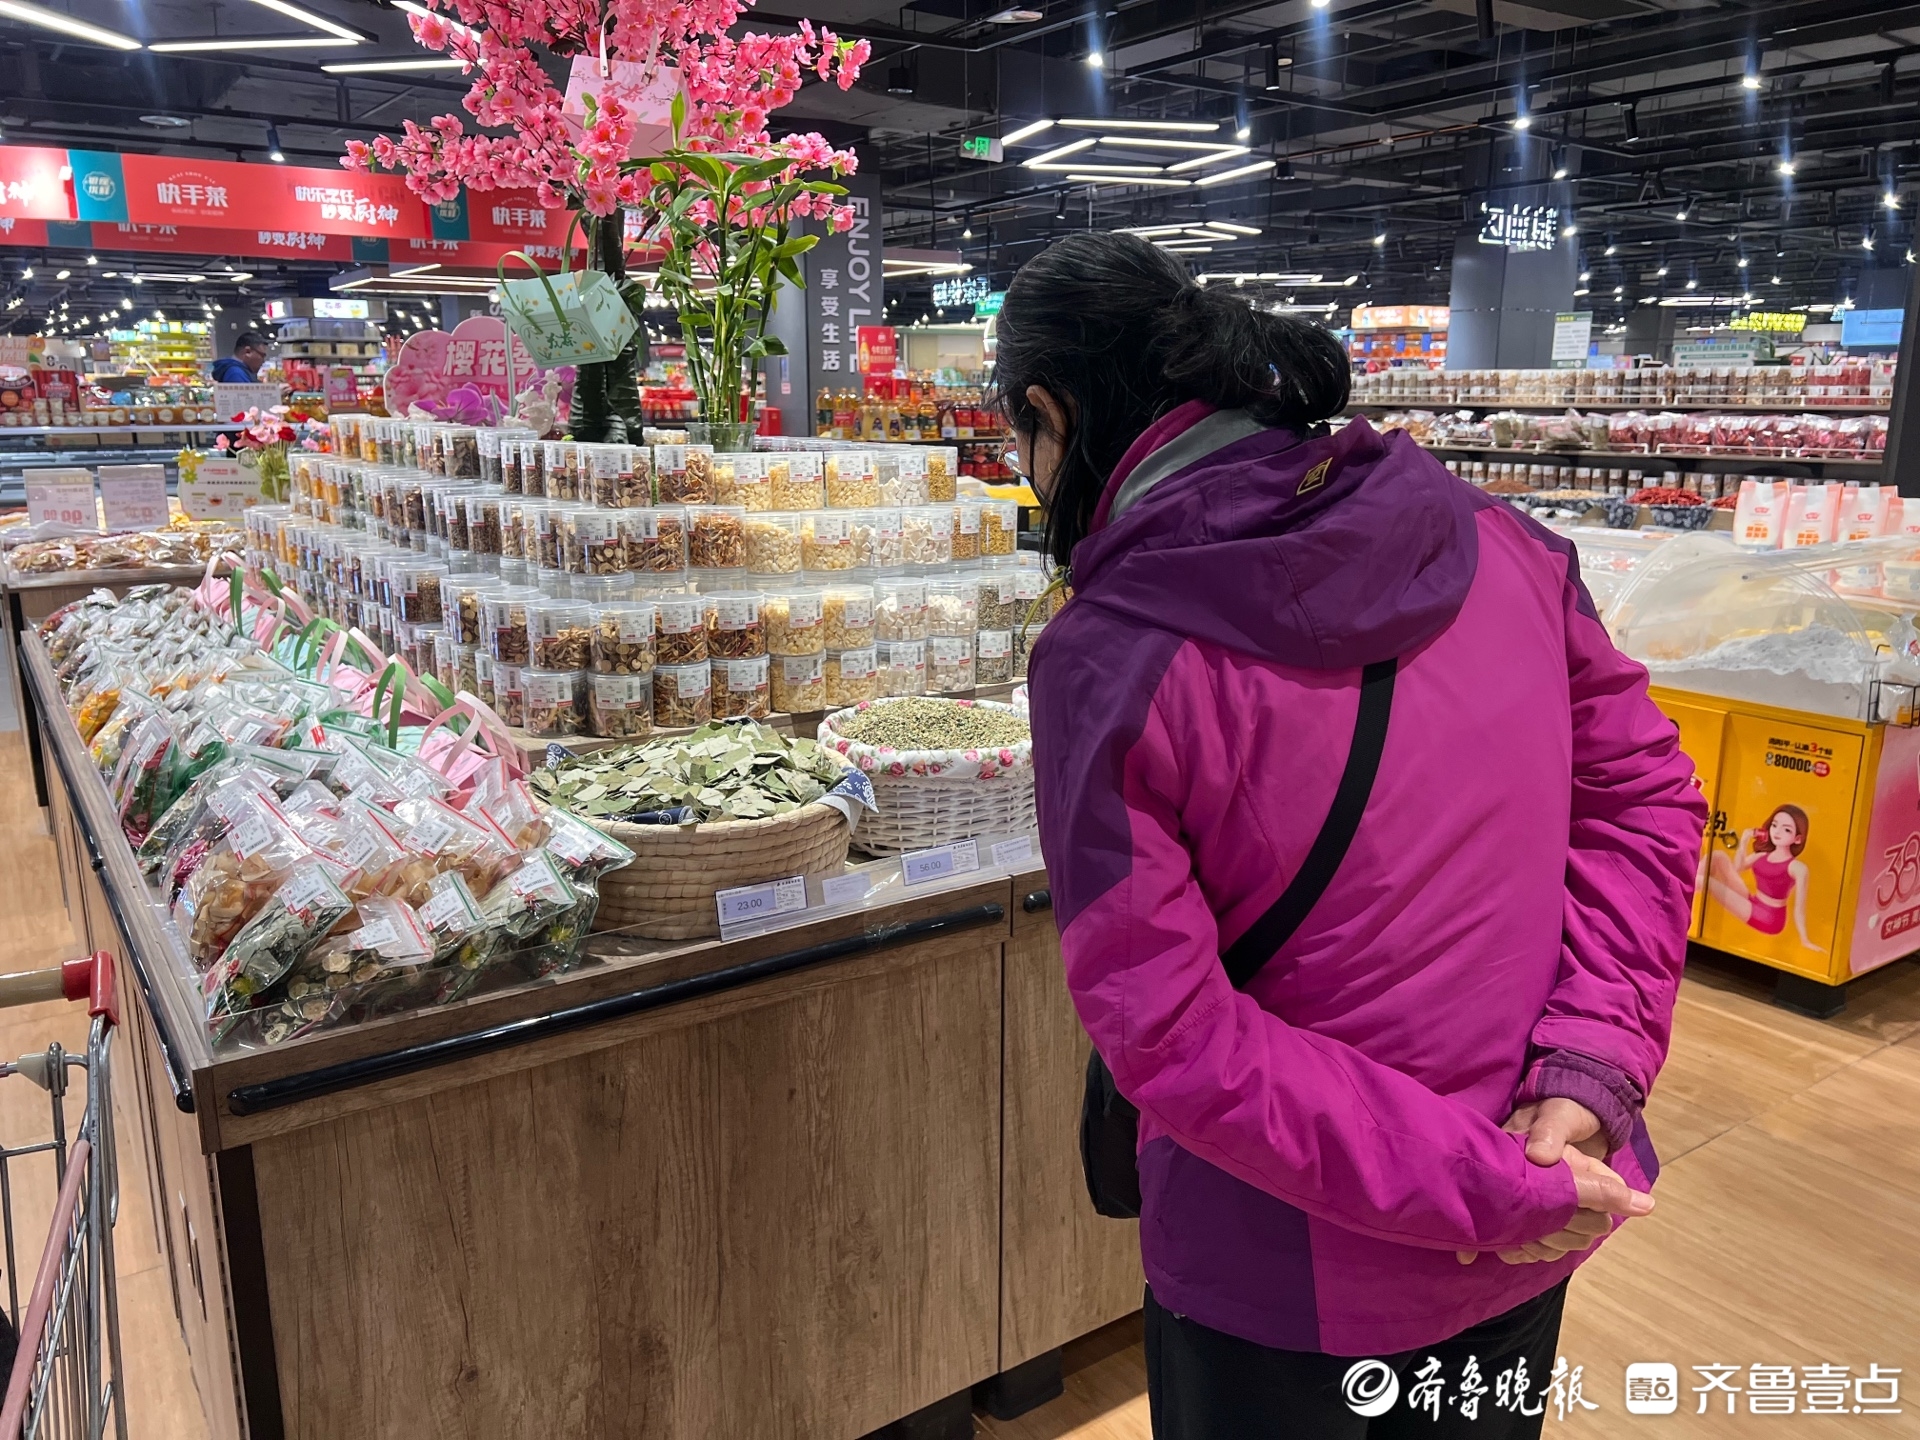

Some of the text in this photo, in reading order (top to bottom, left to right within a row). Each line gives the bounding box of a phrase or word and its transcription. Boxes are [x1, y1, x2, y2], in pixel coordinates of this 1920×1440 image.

[157, 182, 228, 208] 快手菜
[492, 206, 547, 229] 快手菜
[847, 196, 870, 302] ENJOY
[820, 268, 840, 371] 享受生活
[919, 861, 941, 872] 56.00
[737, 898, 762, 911] 23.00
